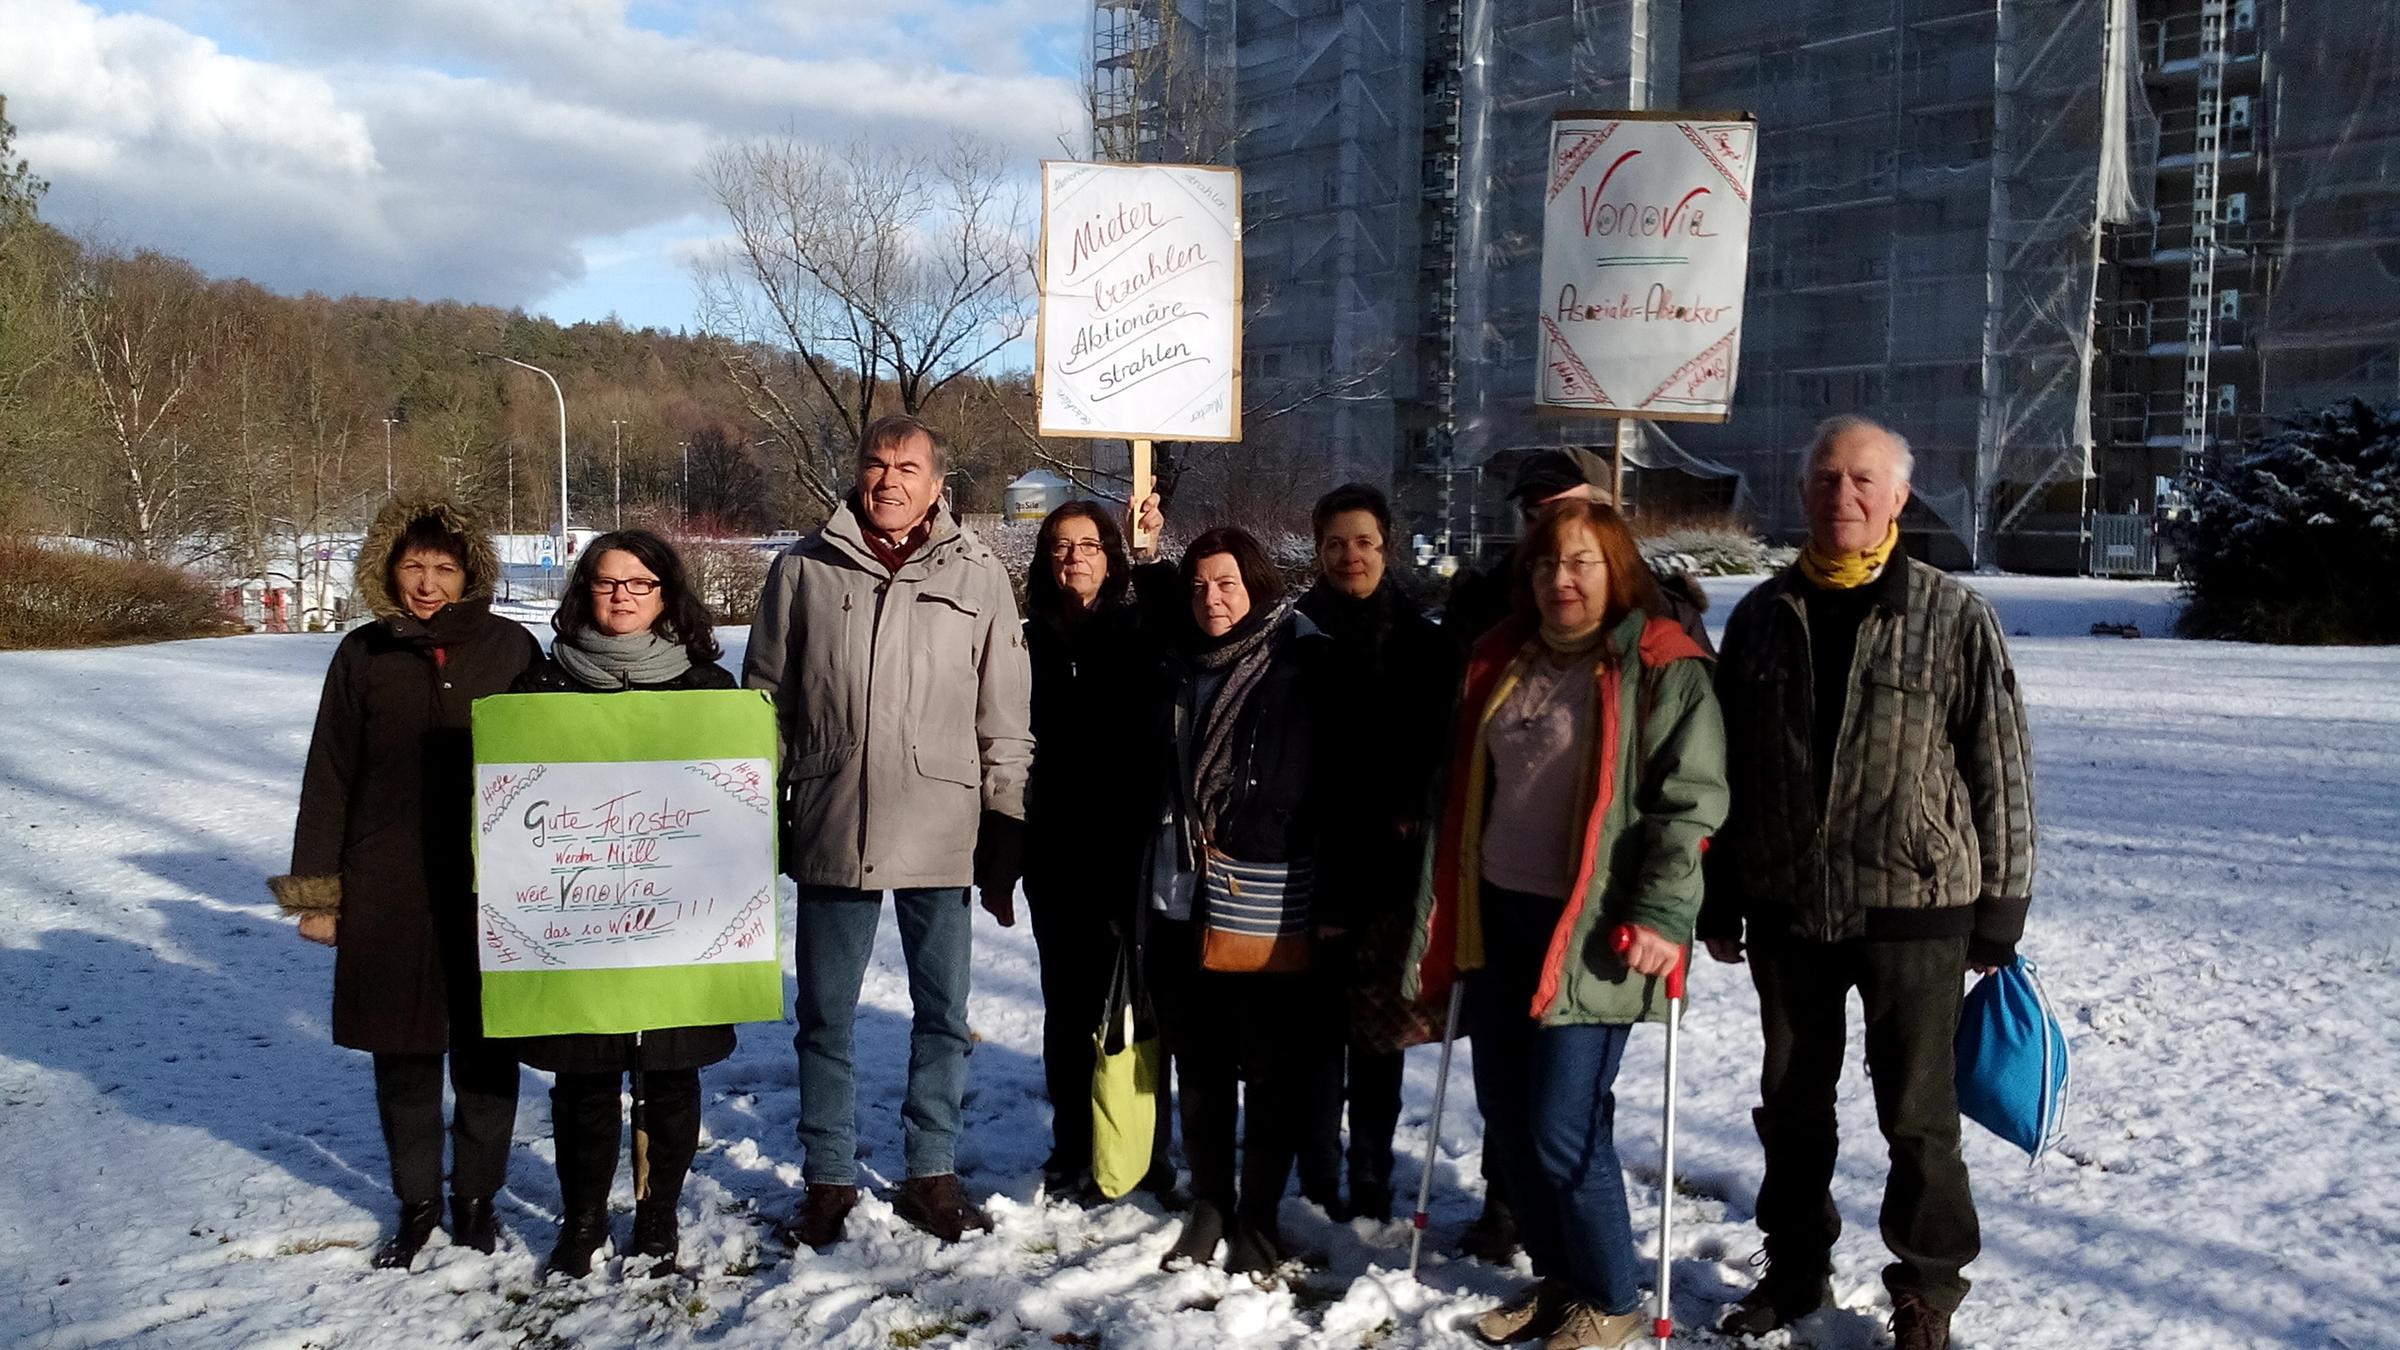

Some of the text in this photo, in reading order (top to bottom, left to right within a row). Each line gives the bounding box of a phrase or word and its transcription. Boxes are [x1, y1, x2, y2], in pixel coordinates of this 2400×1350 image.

[1581, 150, 1719, 239] Vonovia
[1065, 201, 1164, 276] Mieter
[1094, 243, 1207, 313] bezahlen
[1066, 301, 1187, 366] Aktionäre
[524, 790, 711, 847] Gute Fenster
[607, 838, 660, 864] Müll
[560, 867, 673, 911] Vonovia
[544, 921, 571, 940] das
[581, 924, 601, 936] so
